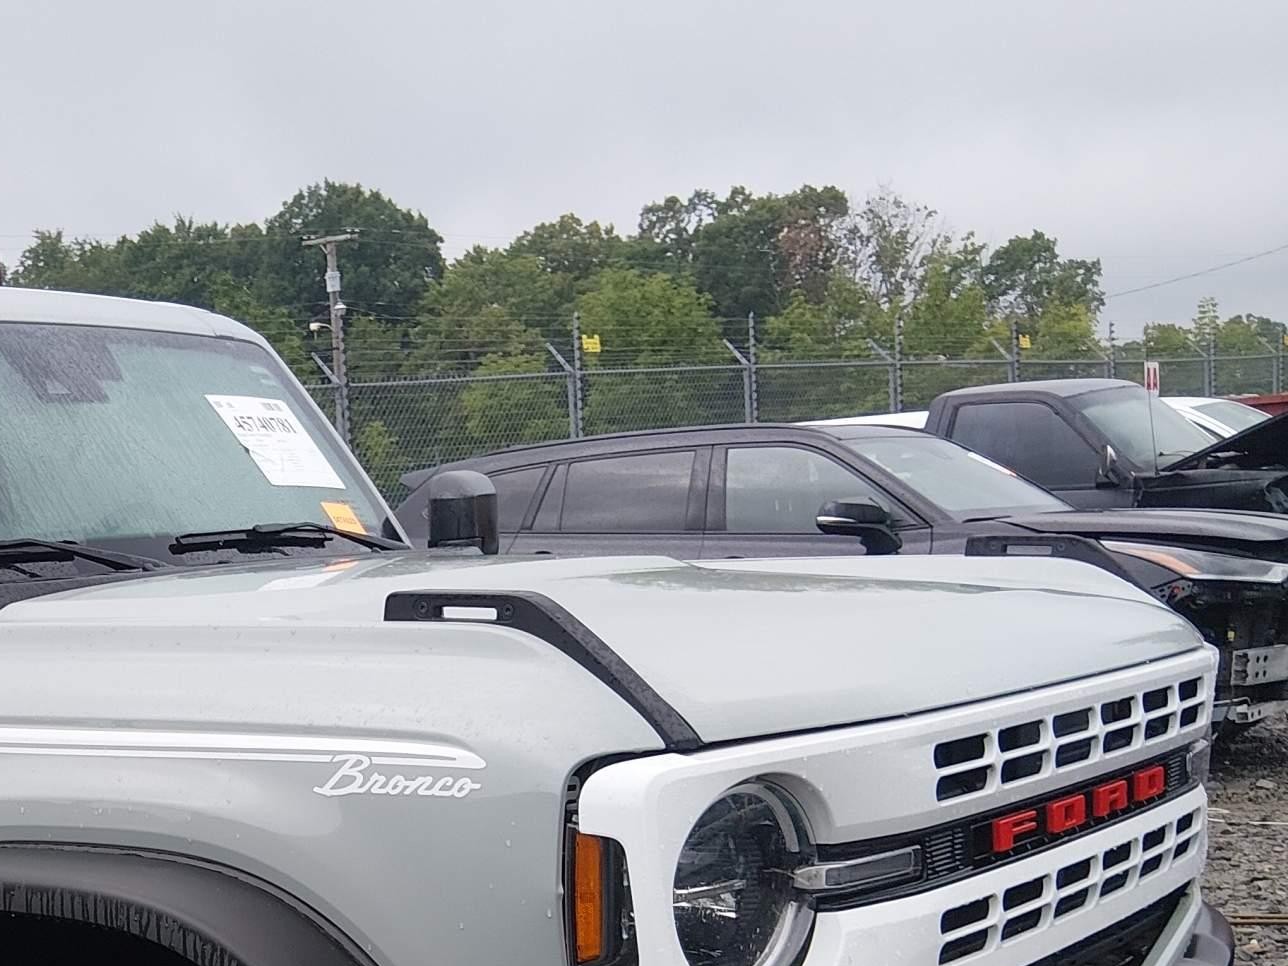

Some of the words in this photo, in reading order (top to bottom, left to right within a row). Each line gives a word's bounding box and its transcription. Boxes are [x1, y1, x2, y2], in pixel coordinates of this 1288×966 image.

[233, 415, 298, 435] 45740781
[313, 754, 482, 798] Bronco
[993, 764, 1166, 853] FORD
